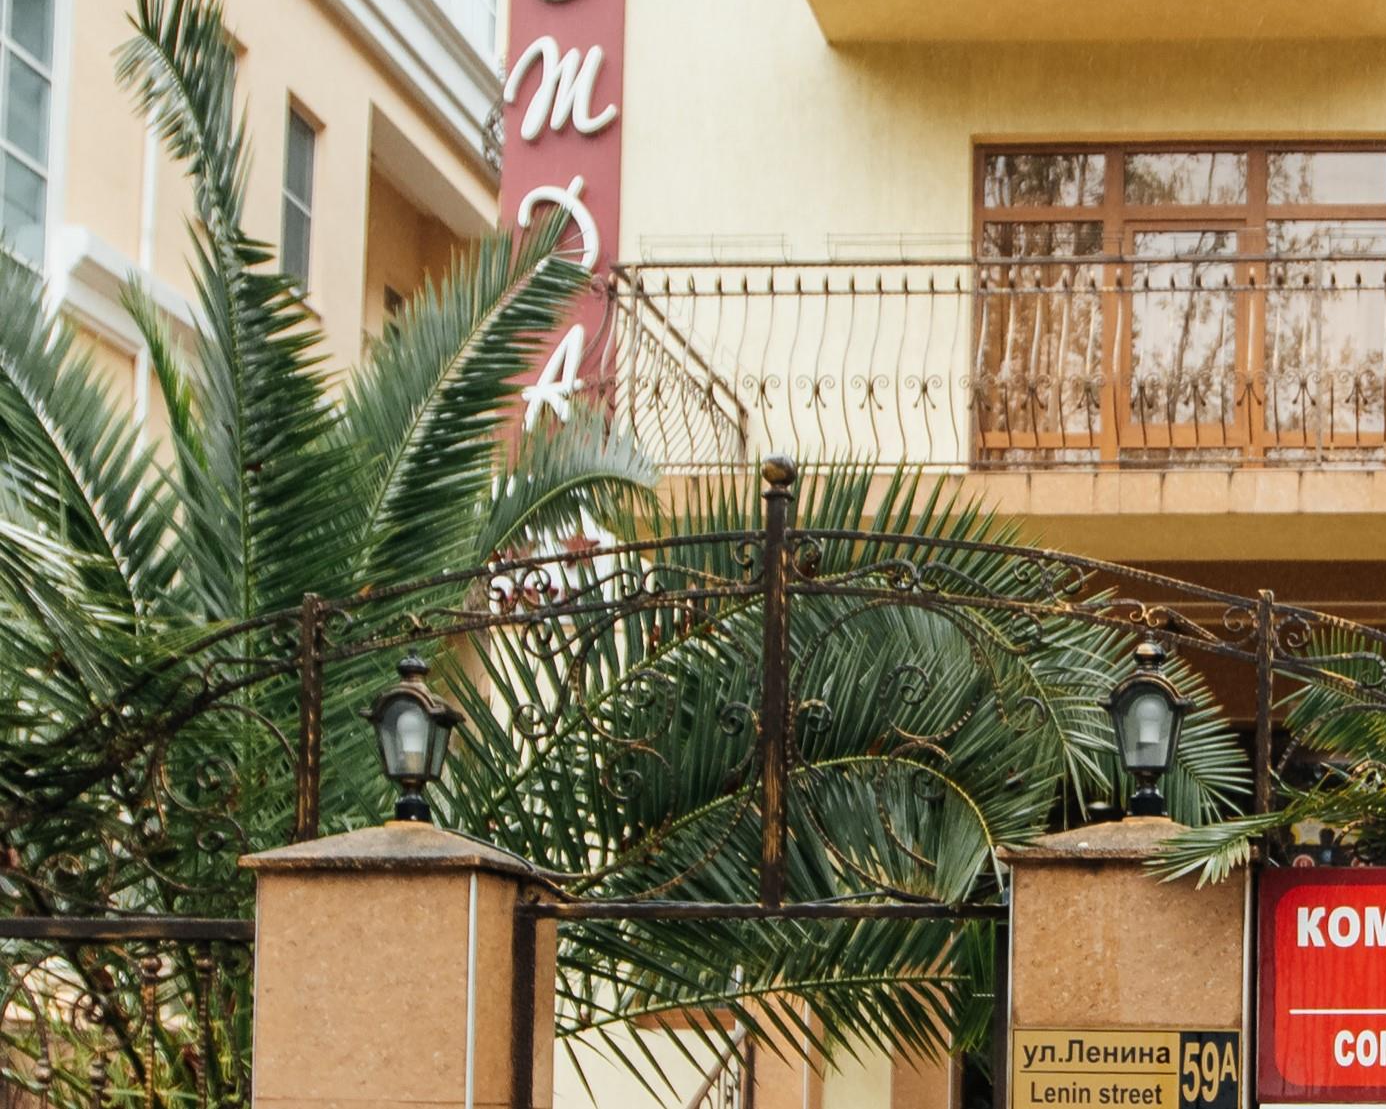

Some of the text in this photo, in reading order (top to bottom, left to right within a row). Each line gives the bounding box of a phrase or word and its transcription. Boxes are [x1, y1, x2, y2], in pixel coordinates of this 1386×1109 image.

[1022, 1039, 1171, 1069] ул.Ленина
[1030, 1081, 1163, 1105] Lenin street
